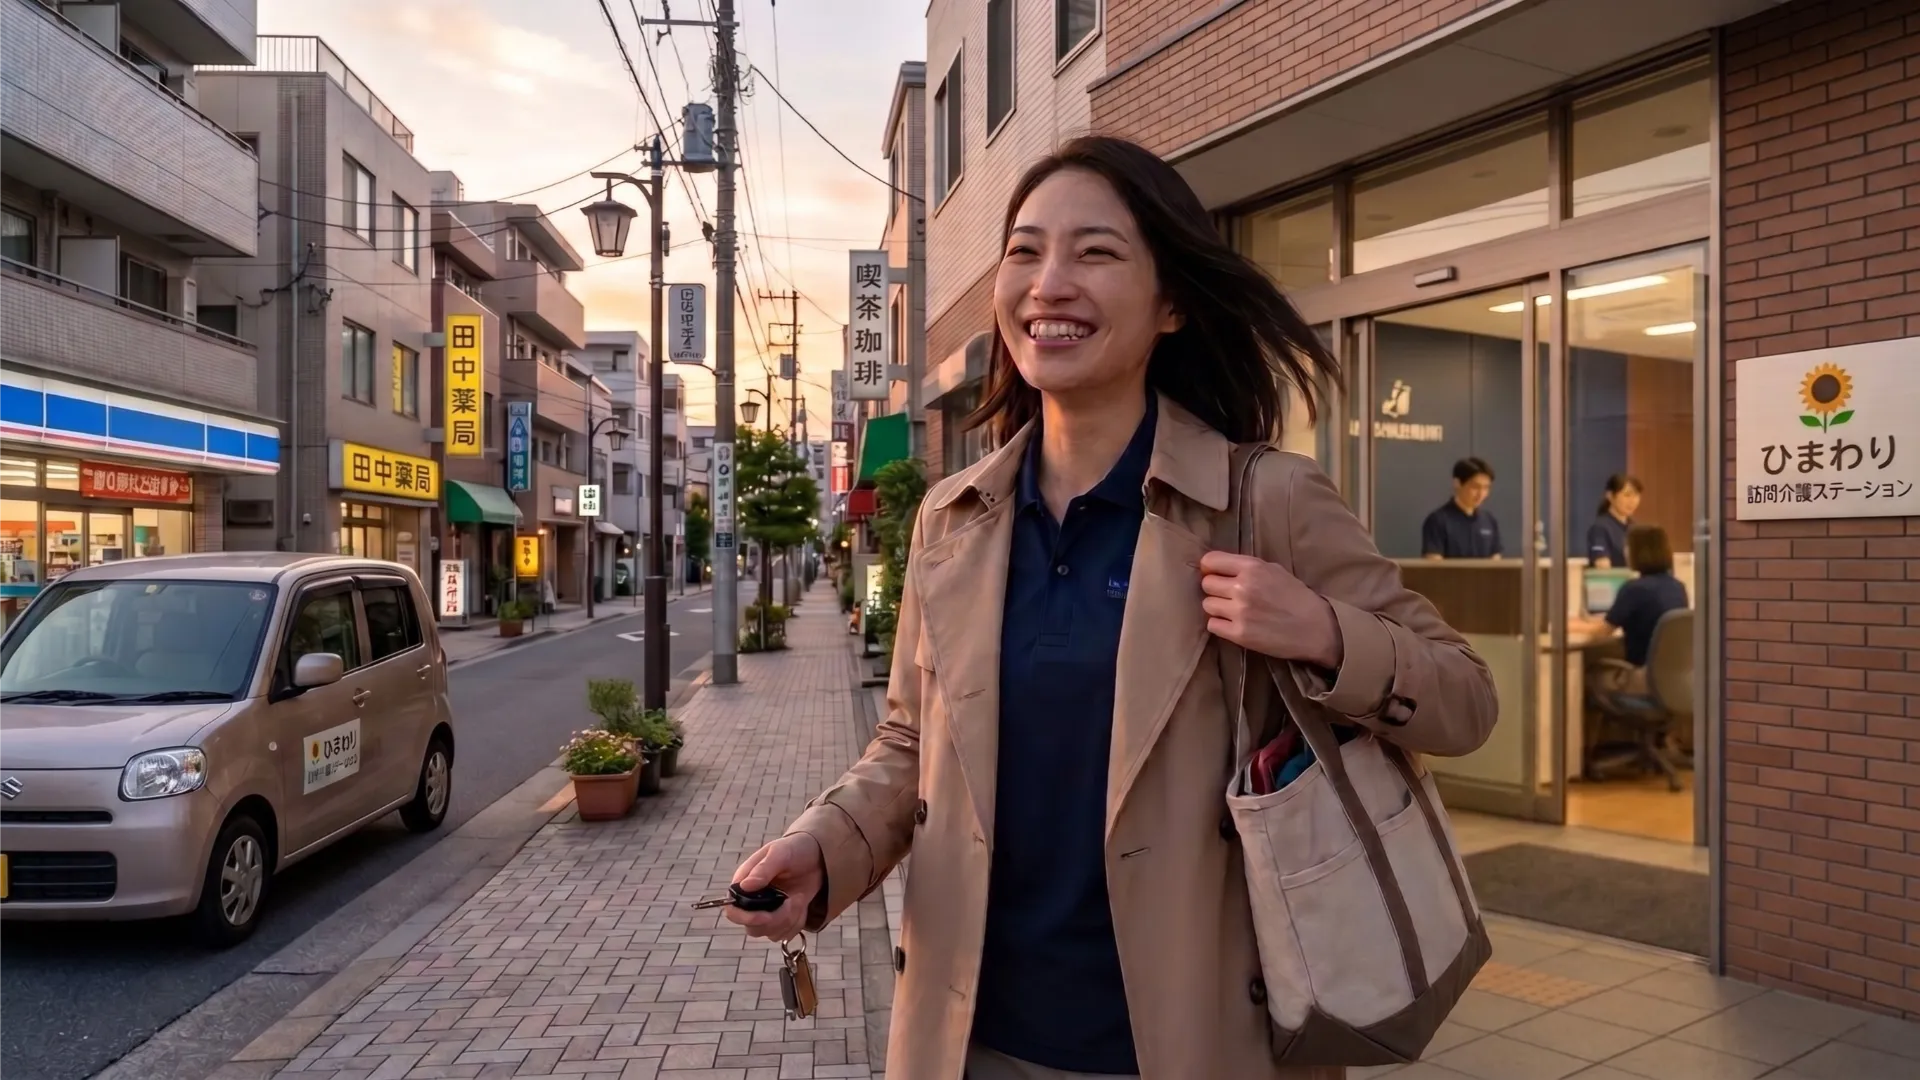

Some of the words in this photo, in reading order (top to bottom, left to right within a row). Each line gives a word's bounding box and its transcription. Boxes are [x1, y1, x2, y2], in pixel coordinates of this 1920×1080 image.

[854, 263, 883, 386] 喫茶珈琲
[451, 324, 477, 446] 田中薬局
[353, 453, 431, 493] 田中薬局
[1761, 434, 1896, 475] ひまわり
[1747, 479, 1913, 504] 訪問介護ステーション
[324, 730, 357, 759] ひまわり
